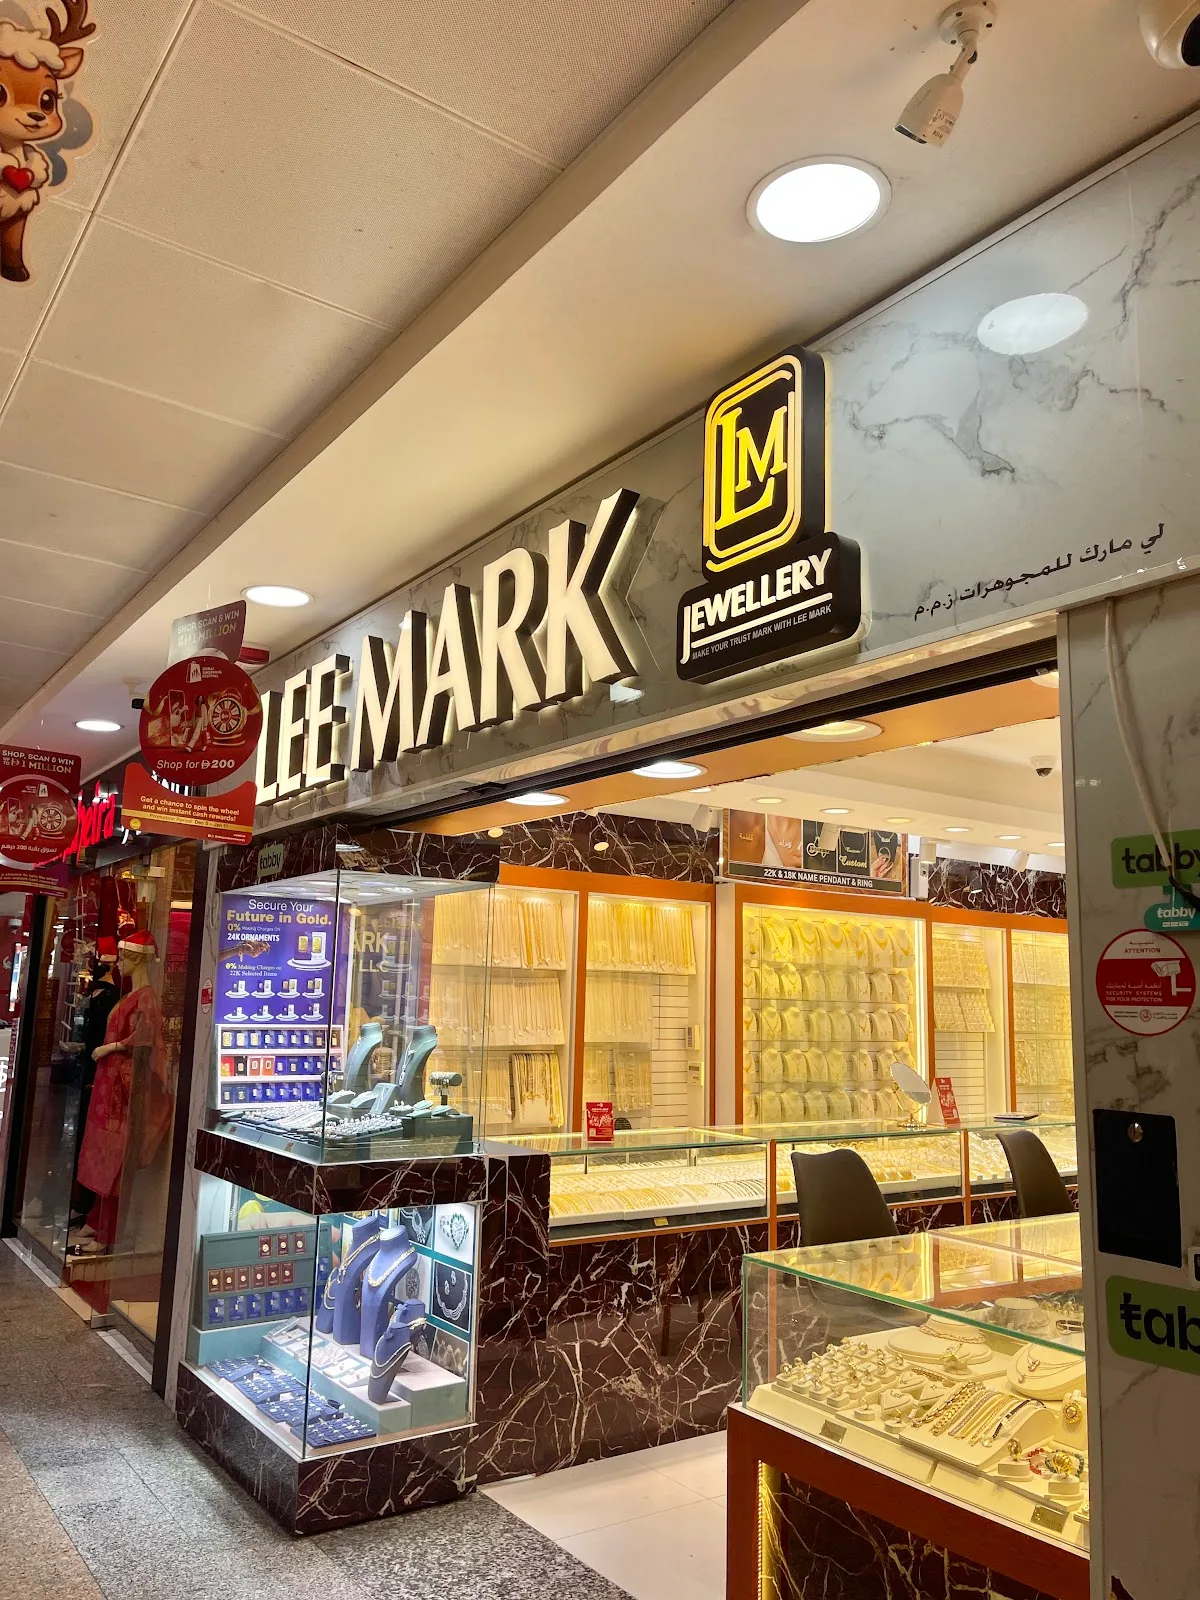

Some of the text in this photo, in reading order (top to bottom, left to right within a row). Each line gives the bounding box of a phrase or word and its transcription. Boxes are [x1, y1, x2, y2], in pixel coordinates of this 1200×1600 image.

[1079, 538, 1132, 563] مارك
[959, 553, 1072, 601] للمجوهرات
[680, 548, 832, 665] JEWELLERY
[198, 615, 218, 628] SCAN
[224, 609, 240, 621] WIN
[199, 622, 237, 641] MILLION
[692, 604, 832, 660] MAKE YOUR TRUST MARK WITH LEE MARK
[255, 487, 640, 806] LEE MARK
[28, 754, 50, 762] SCAN
[58, 758, 74, 766] WIN
[28, 761, 72, 774] MILLION
[157, 760, 182, 771] Shop
[185, 760, 200, 769] for
[140, 795, 153, 803] Get
[160, 798, 184, 808] chance
[194, 803, 207, 812] spin
[209, 805, 219, 813] the
[220, 807, 240, 816] wheel
[169, 807, 192, 816] instant
[209, 813, 236, 822] rewards!
[260, 852, 282, 870] tabby
[839, 854, 867, 868] Custom
[763, 868, 873, 888] 22K & 18K NAME PENDANT & RING
[248, 898, 314, 912] Secure Your
[1157, 907, 1196, 919] tabby
[226, 910, 332, 925] Future in Gold.
[227, 923, 241, 931] 0%
[227, 933, 280, 942] 24K ORNAMENTS
